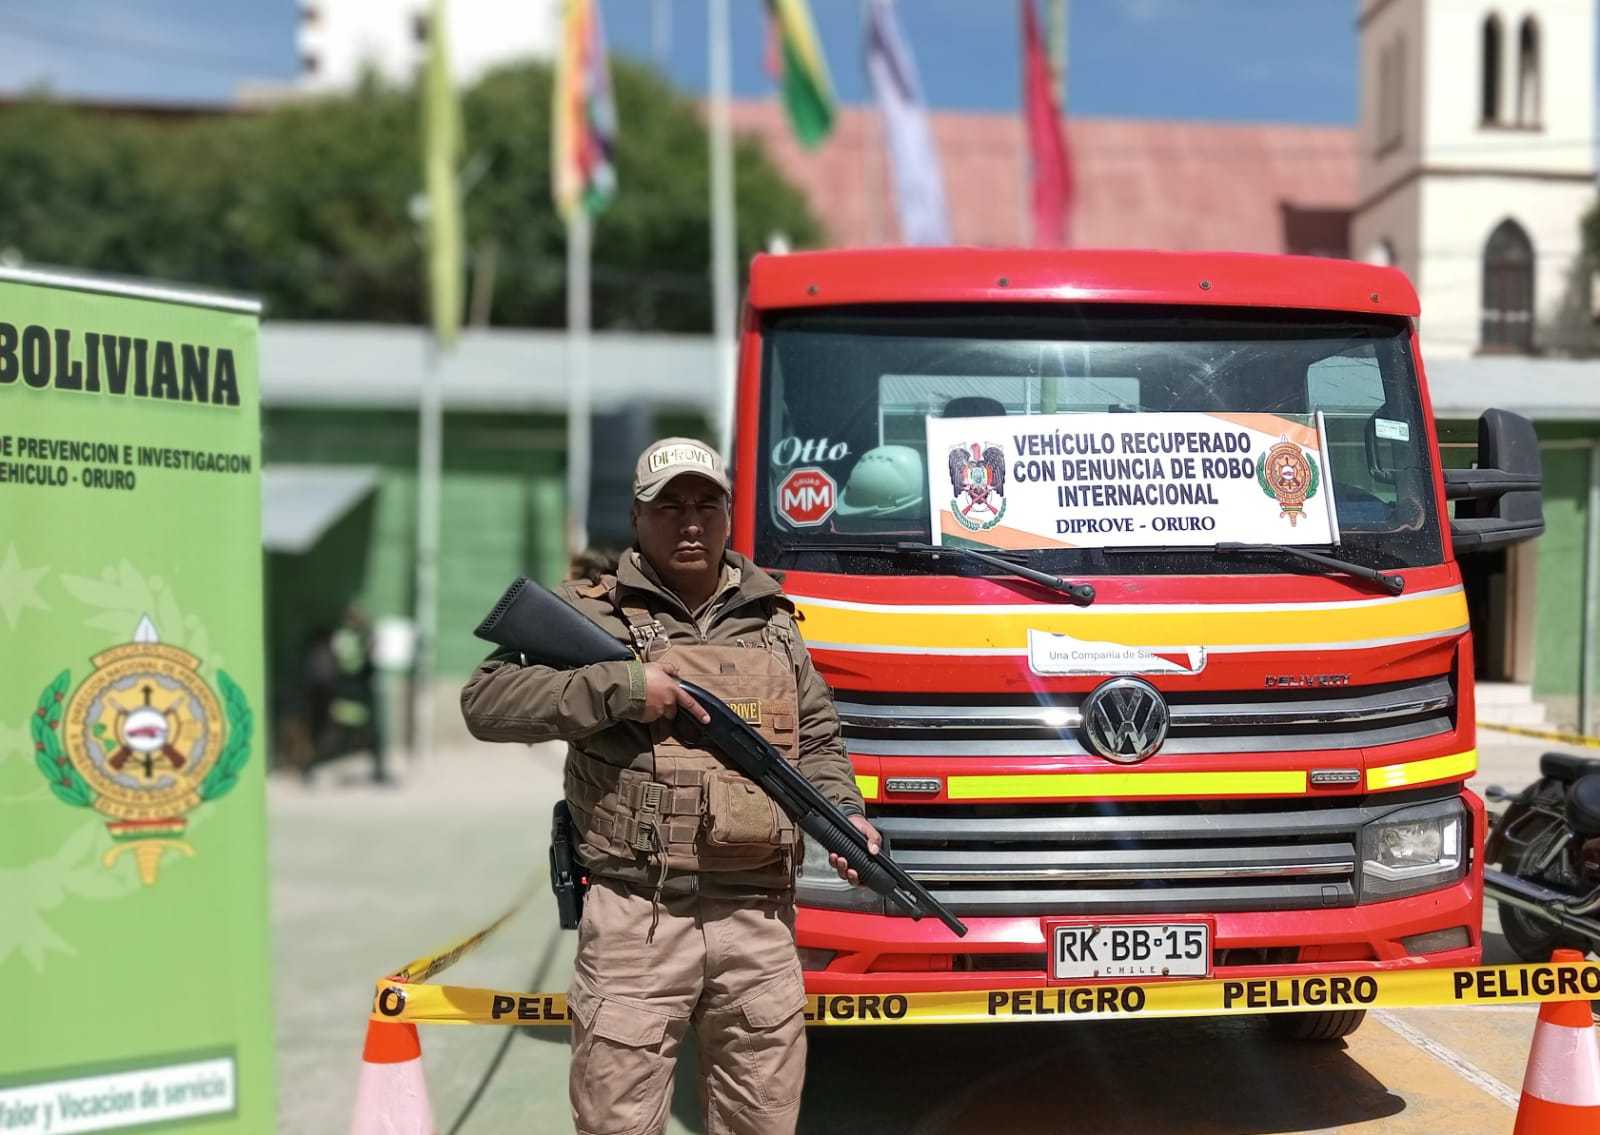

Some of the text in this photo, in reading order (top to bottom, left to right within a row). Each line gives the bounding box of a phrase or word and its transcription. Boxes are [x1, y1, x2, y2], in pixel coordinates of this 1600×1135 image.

[0, 322, 240, 406] BOLIVIANA
[17, 437, 118, 464] PREVENCION
[124, 445, 133, 465] E
[138, 446, 251, 473] INVESTIGACION
[772, 436, 849, 466] Otto
[1013, 428, 1251, 456] VEHÍCULO RECUPERADO
[82, 467, 136, 490] ORURO
[1013, 457, 1255, 482] CON DENUNCIA DE ROBO
[784, 485, 829, 512] MM
[1057, 483, 1219, 507] INTERNACIONAL
[1056, 517, 1135, 534] DIPROVE
[1151, 516, 1216, 532] ORURO
[726, 702, 758, 721] ROVE
[988, 986, 1146, 1016] PELIGRO
[1223, 975, 1378, 1009] PELIGRO
[1453, 966, 1600, 999] PELIGRO
